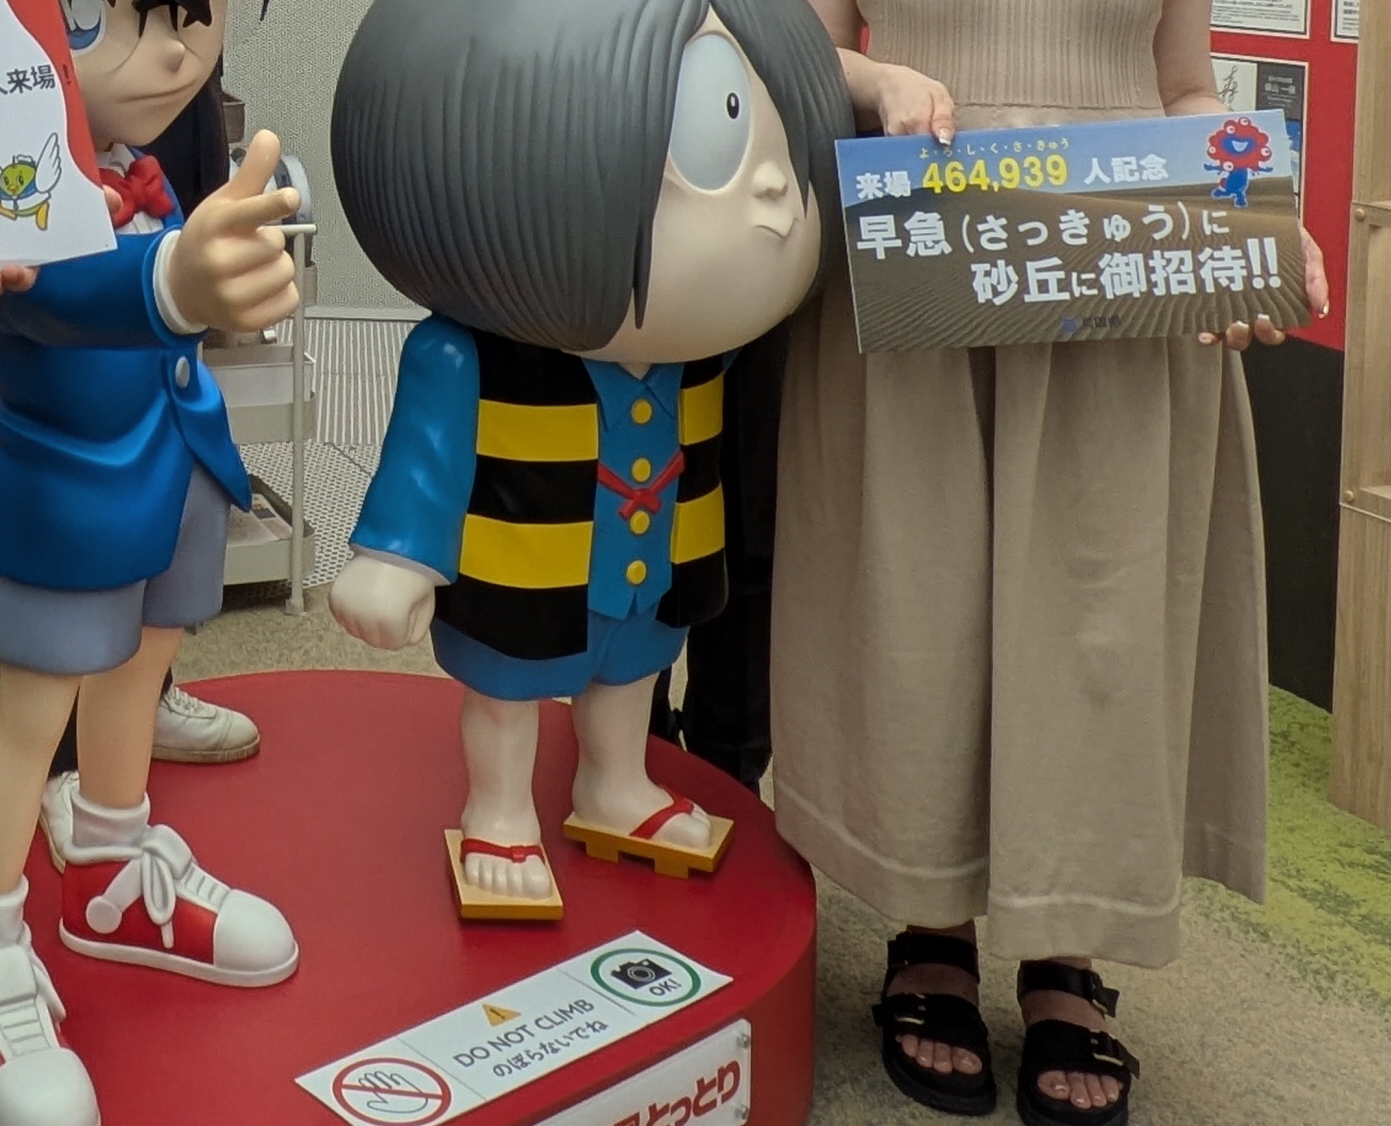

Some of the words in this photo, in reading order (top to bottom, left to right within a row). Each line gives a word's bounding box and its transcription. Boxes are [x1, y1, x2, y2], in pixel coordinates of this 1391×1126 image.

[855, 171, 912, 201] 来場
[921, 153, 1069, 196] 464,939
[1083, 154, 1169, 187] 人記念
[856, 200, 1231, 261] 早急(さっきゅう)に
[970, 237, 1283, 306] 砂丘に御招待!!
[648, 977, 680, 998] OK!
[452, 1045, 491, 1070] DO
[489, 1023, 537, 1054] NOT
[533, 997, 596, 1032] CLIMB
[492, 1019, 609, 1079] のぼらないでね
